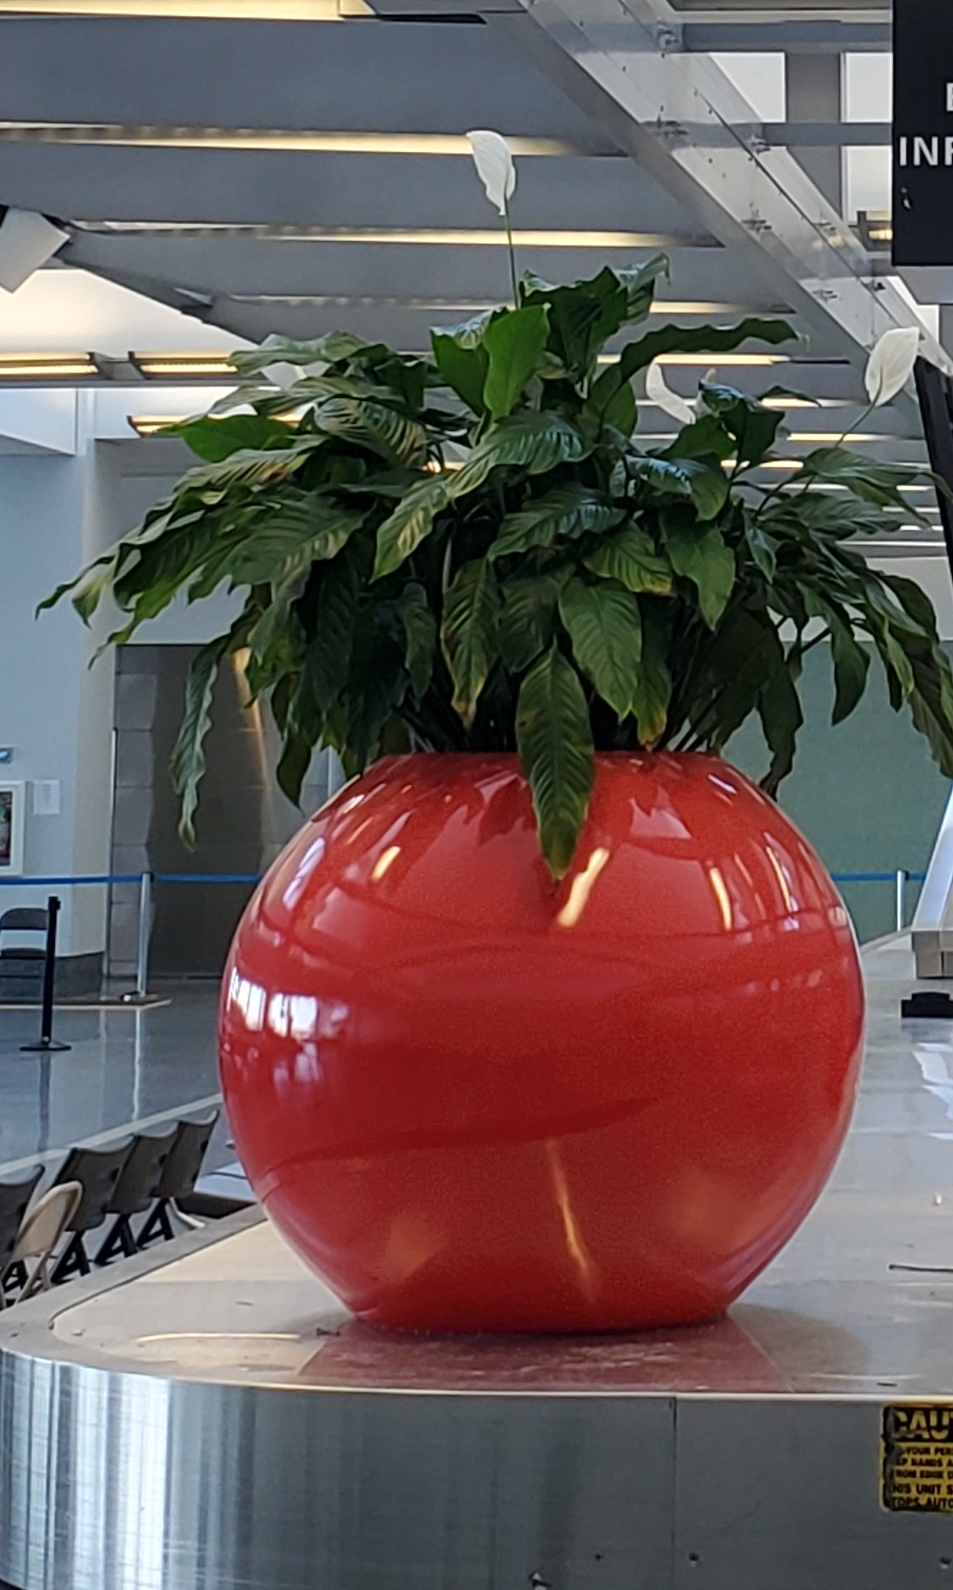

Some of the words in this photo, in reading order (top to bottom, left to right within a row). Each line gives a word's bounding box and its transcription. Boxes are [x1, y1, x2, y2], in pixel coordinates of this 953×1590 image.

[906, 1446, 931, 1456] YOUR
[911, 1457, 943, 1468] HANDS
[920, 1470, 943, 1479] EDGE
[916, 1483, 941, 1495] UNIT
